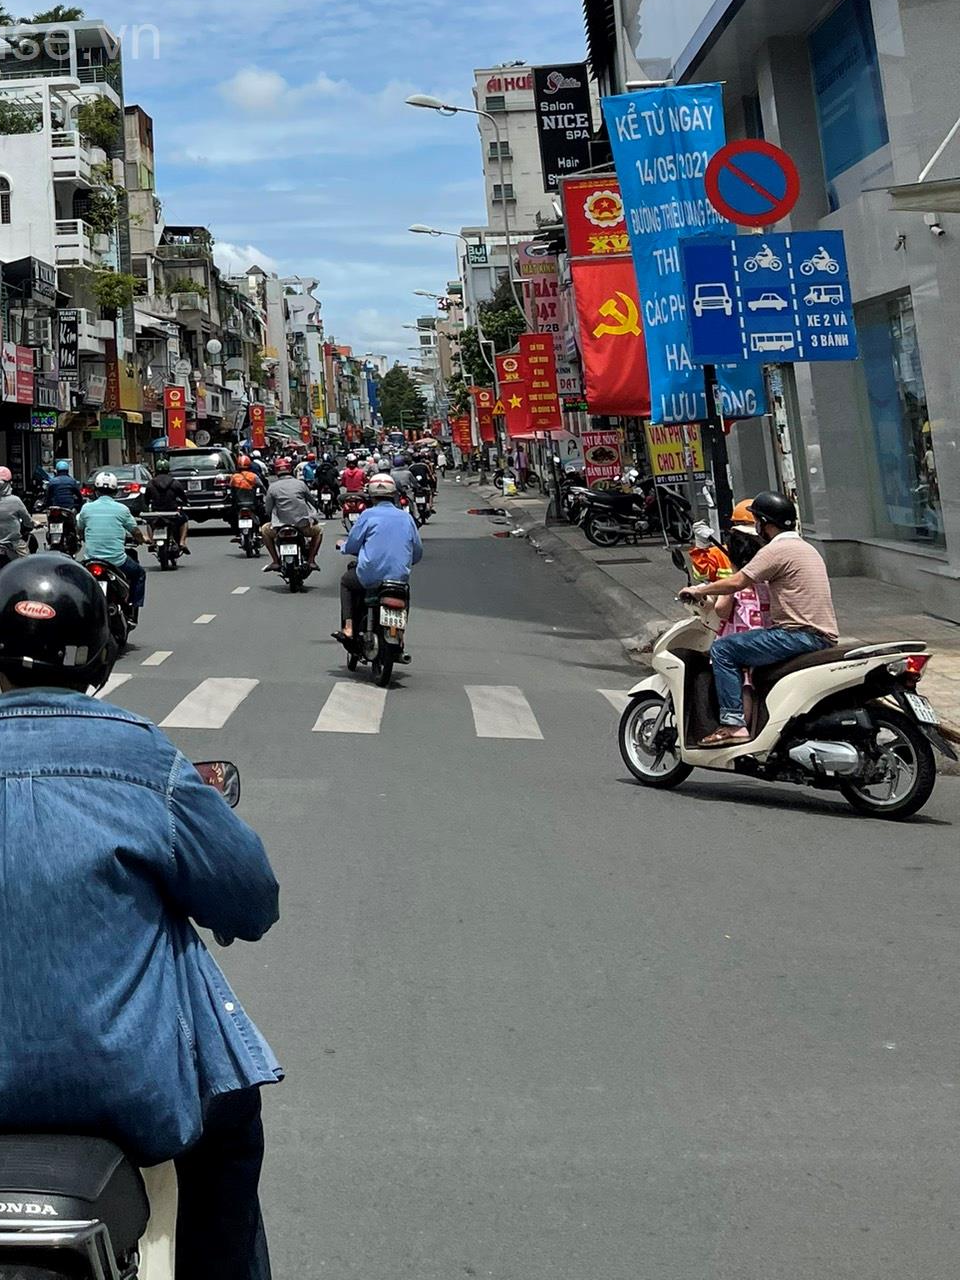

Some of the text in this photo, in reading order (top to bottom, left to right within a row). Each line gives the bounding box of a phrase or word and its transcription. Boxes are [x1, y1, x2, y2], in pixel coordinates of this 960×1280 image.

[540, 101, 574, 111] Salon
[542, 113, 589, 130] NICE
[615, 98, 713, 142] KỂ TỪ NGÀY
[566, 130, 590, 140] SPA
[558, 156, 580, 168] Hair
[646, 291, 668, 327] CÁC
[807, 310, 848, 327] XE 2 VÀ
[811, 330, 849, 347] 3 BÁNH
[661, 391, 697, 421] LƯU
[657, 452, 675, 471] CHO
